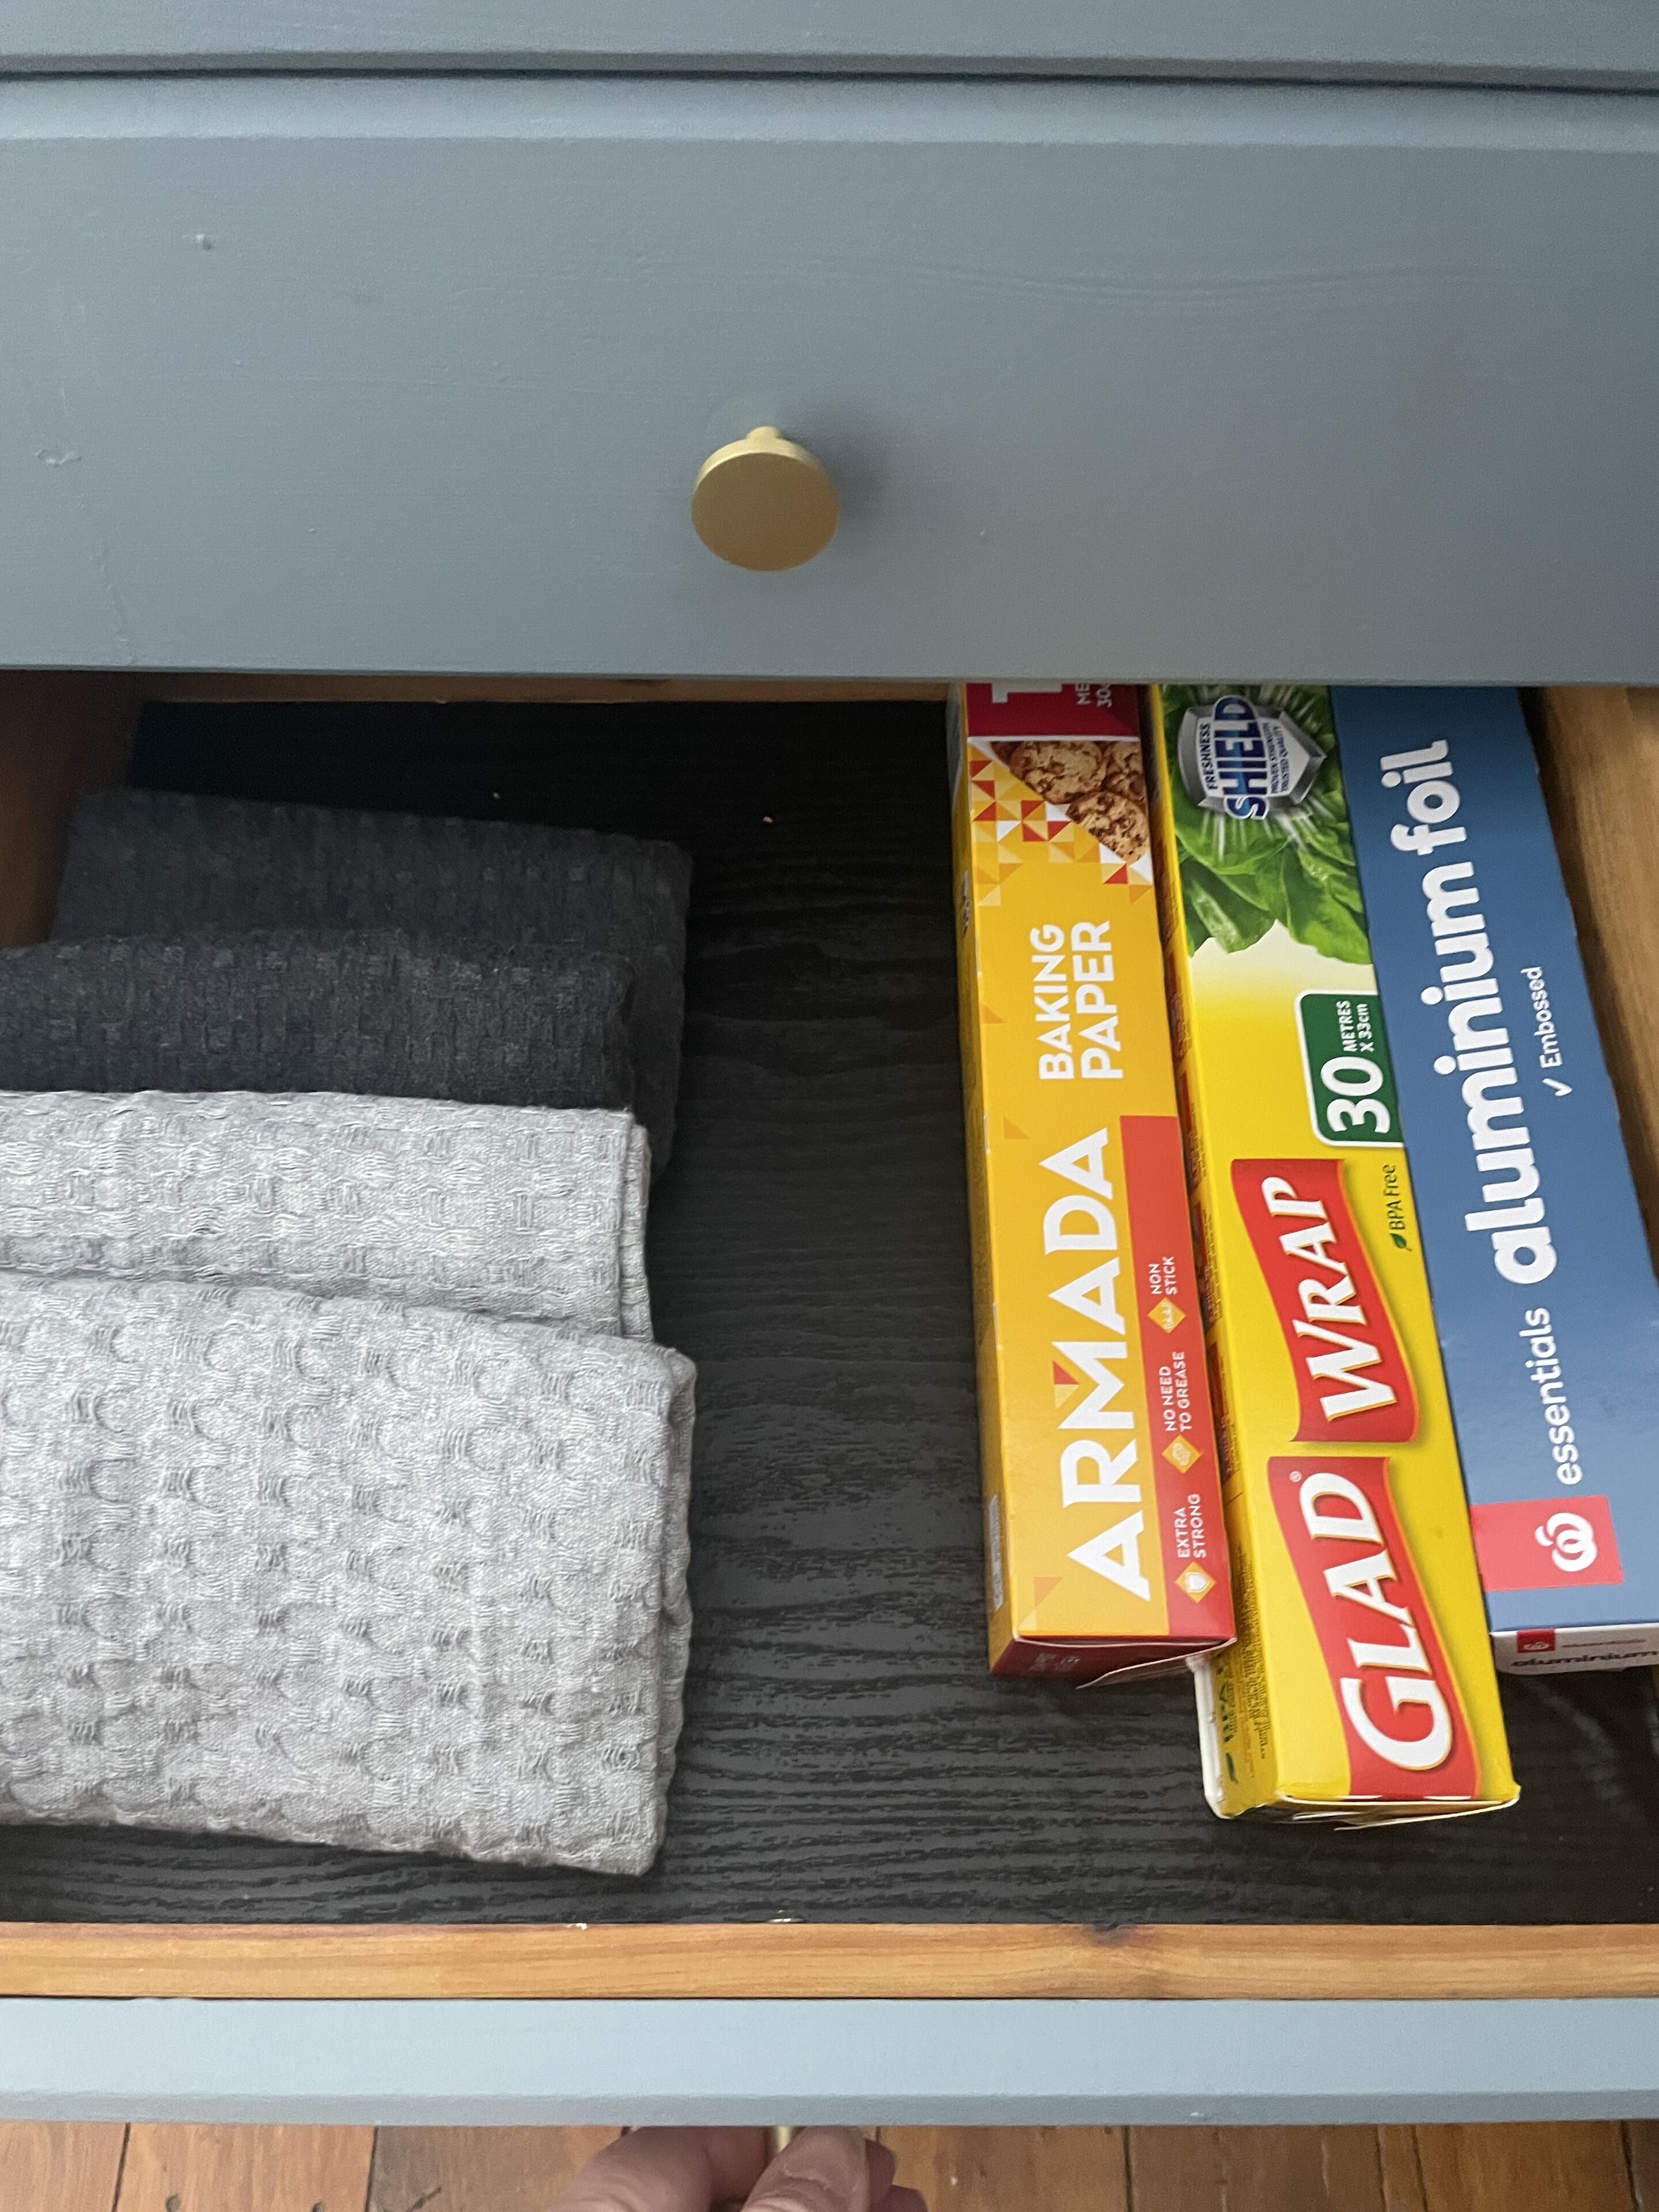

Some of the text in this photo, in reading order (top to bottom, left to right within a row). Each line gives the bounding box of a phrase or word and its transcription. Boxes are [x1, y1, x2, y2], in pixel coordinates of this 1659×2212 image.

[1199, 723, 1218, 790] FRESHNESS
[1213, 695, 1268, 819] SHIELD
[1029, 924, 1074, 1079] BAKING
[1070, 919, 1124, 1079] PAPER
[1520, 966, 1563, 1068] Embossed
[1320, 1000, 1391, 1134] 30 METRES
[1380, 739, 1582, 1485] essentials aluminium foil
[1383, 1164, 1406, 1231] BPA Free
[1149, 1263, 1162, 1295] NON
[1162, 1256, 1175, 1296] STICK
[1039, 1127, 1151, 1602] ARMADA
[1159, 1366, 1177, 1432] NO NEED
[1172, 1351, 1192, 1433] TO GREASE
[1261, 1176, 1453, 1771] GLAD WRAP
[1174, 1506, 1190, 1559] EXTRA
[1187, 1494, 1207, 1559] STRONG
